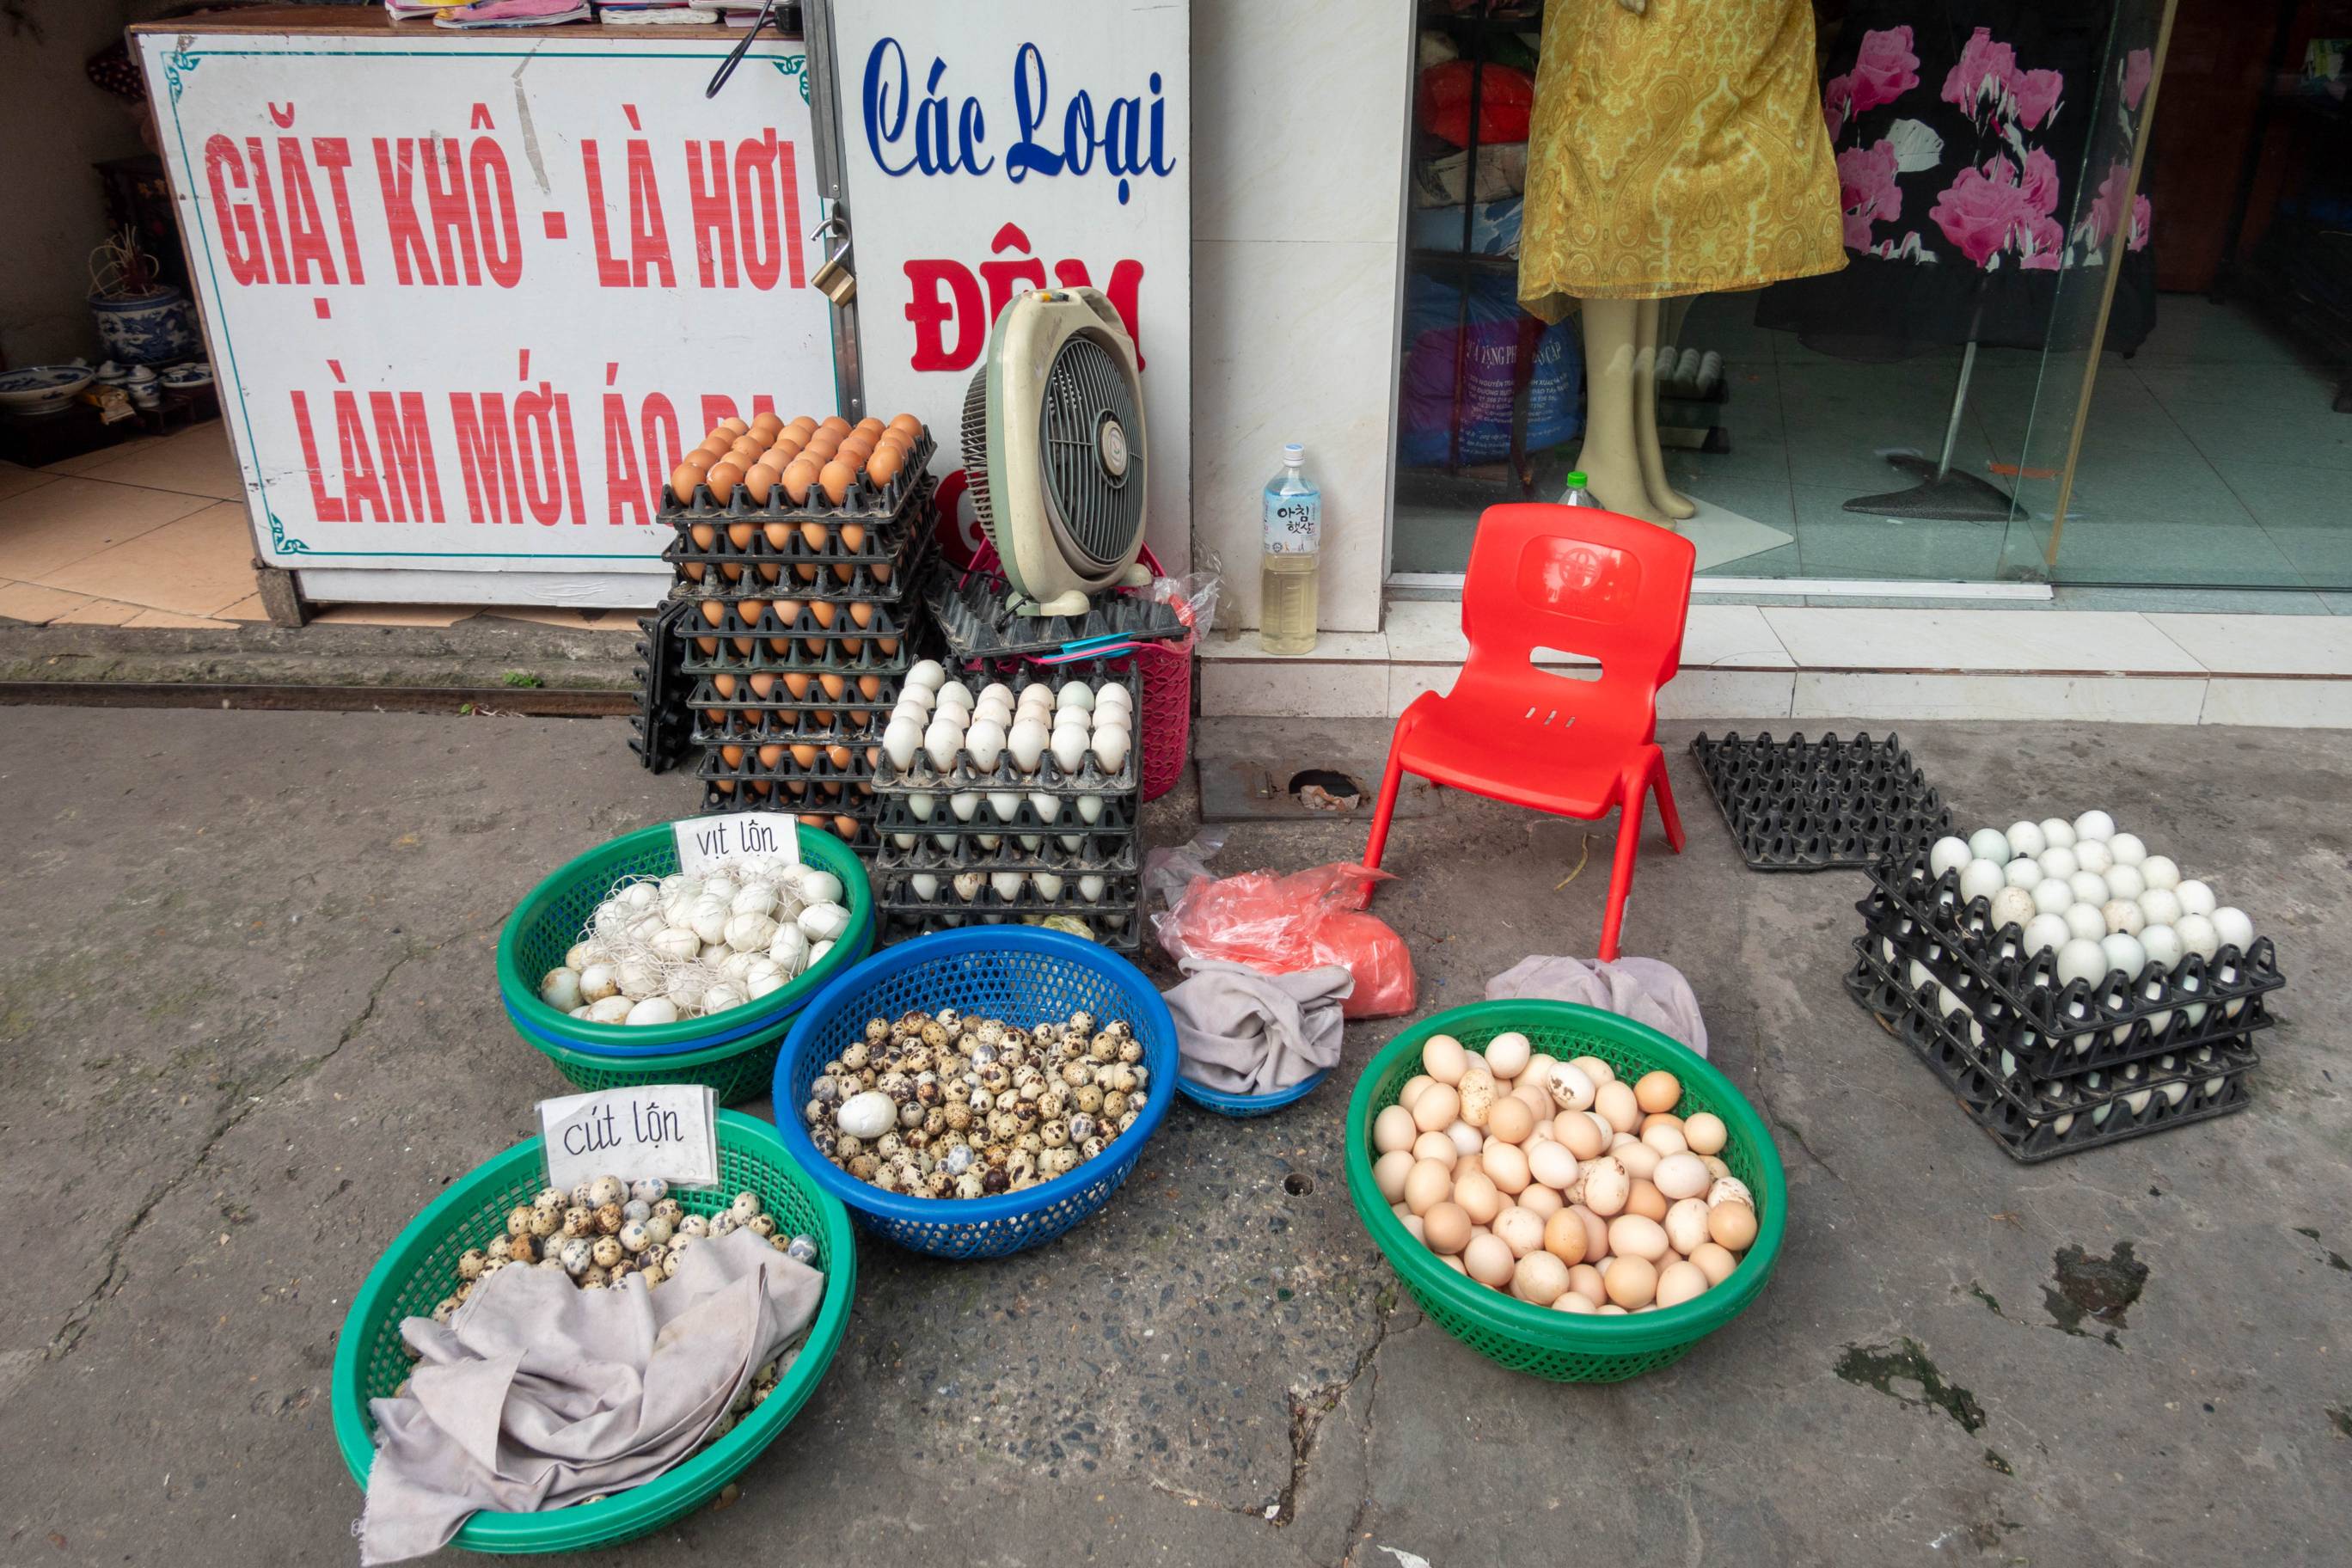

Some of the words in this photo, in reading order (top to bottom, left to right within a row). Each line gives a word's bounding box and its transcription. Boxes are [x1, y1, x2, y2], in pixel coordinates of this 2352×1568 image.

[862, 37, 995, 177] Các
[1005, 41, 1176, 205] Loại
[205, 101, 366, 320] GIẶT
[371, 101, 524, 290] KHÔ
[579, 103, 677, 289] LÀ
[683, 127, 807, 291] HƠI
[290, 359, 446, 524] LÀM
[448, 348, 587, 527] MỚI
[602, 362, 683, 527] ÁO
[1277, 504, 1309, 522] 아침
[1286, 521, 1314, 534] 햇살
[696, 822, 729, 860] vịt
[740, 818, 778, 857] lộn
[633, 1100, 684, 1148] lộn
